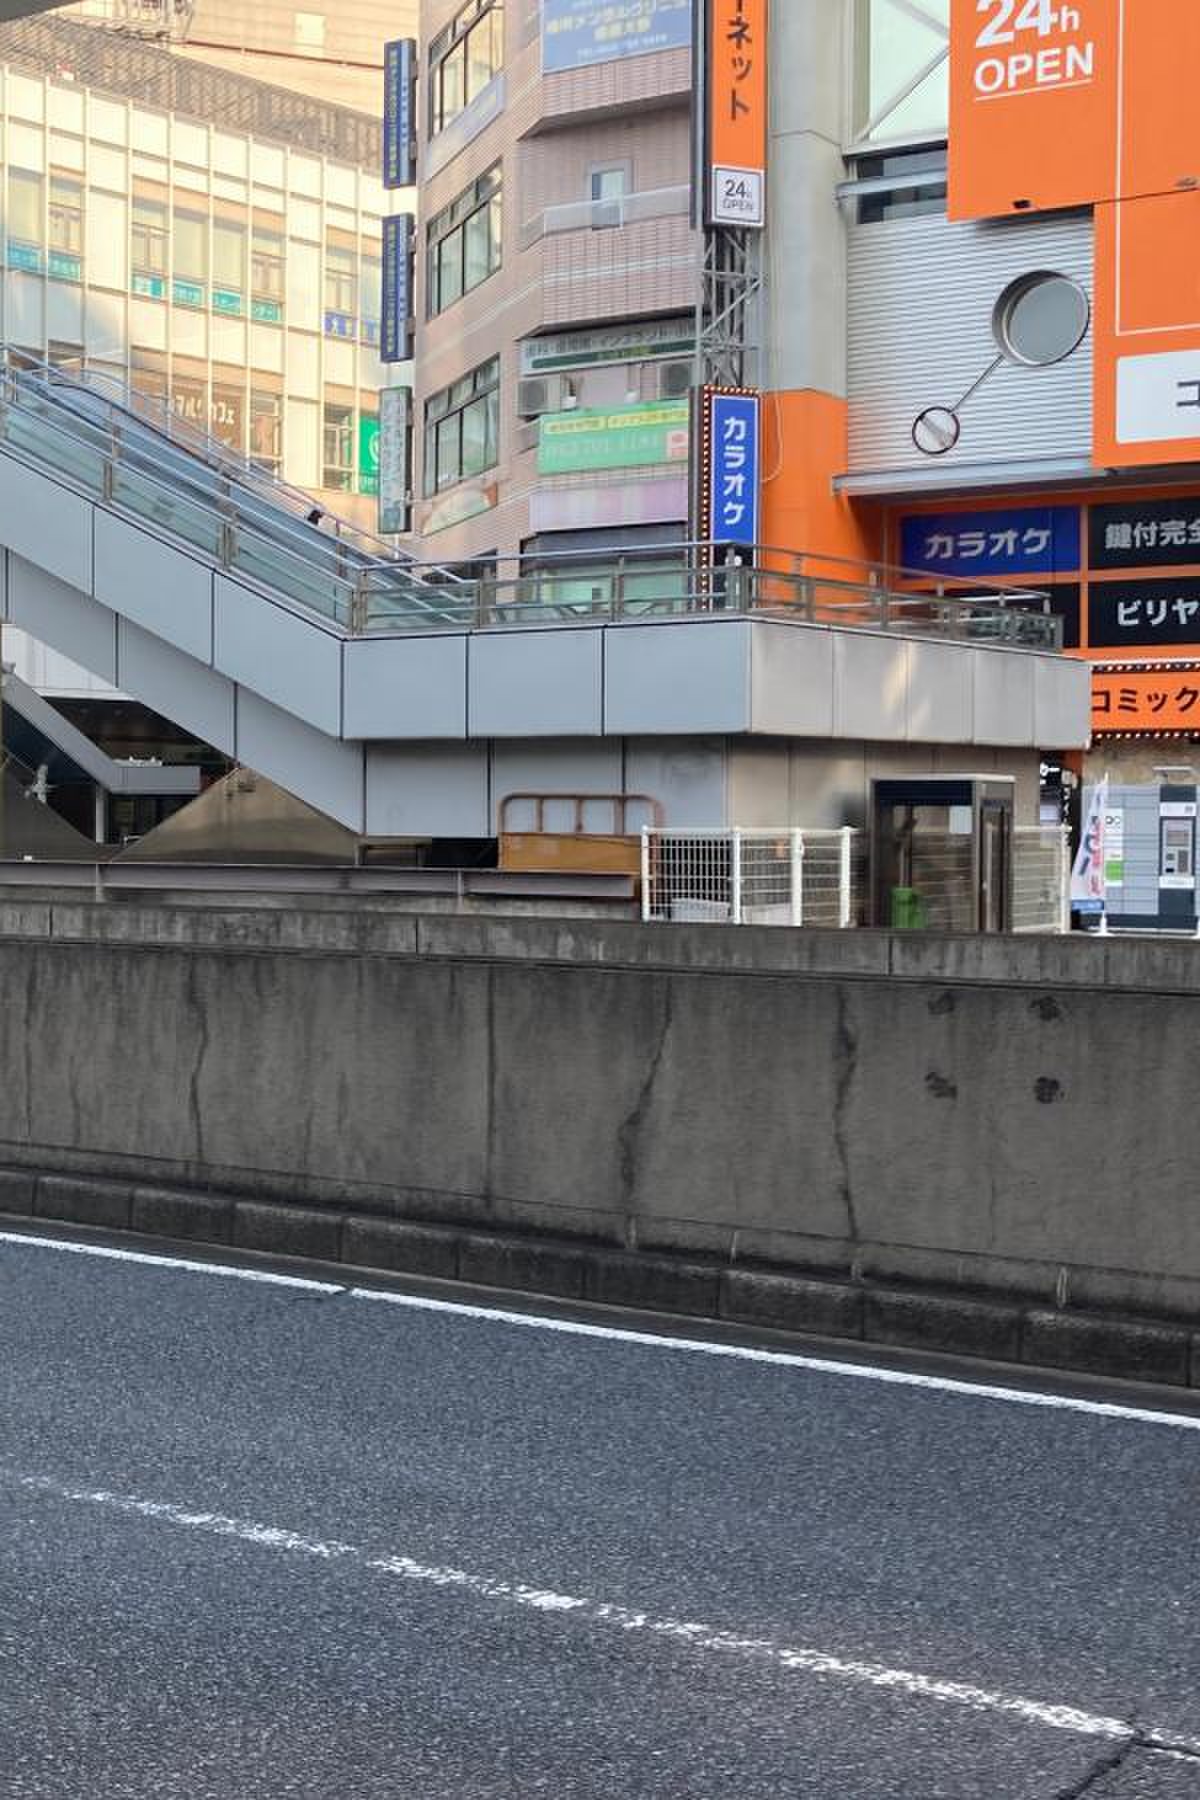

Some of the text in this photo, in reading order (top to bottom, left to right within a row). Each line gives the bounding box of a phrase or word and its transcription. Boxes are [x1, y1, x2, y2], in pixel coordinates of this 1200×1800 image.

[974, 0, 1080, 48] 24h
[974, 41, 1094, 93] OPEN
[722, 197, 754, 212] OPEN
[723, 416, 747, 525] カラオケ
[924, 527, 1051, 560] カラオケ
[1116, 597, 1200, 627] ビリヤ
[1091, 686, 1200, 713] コミック
